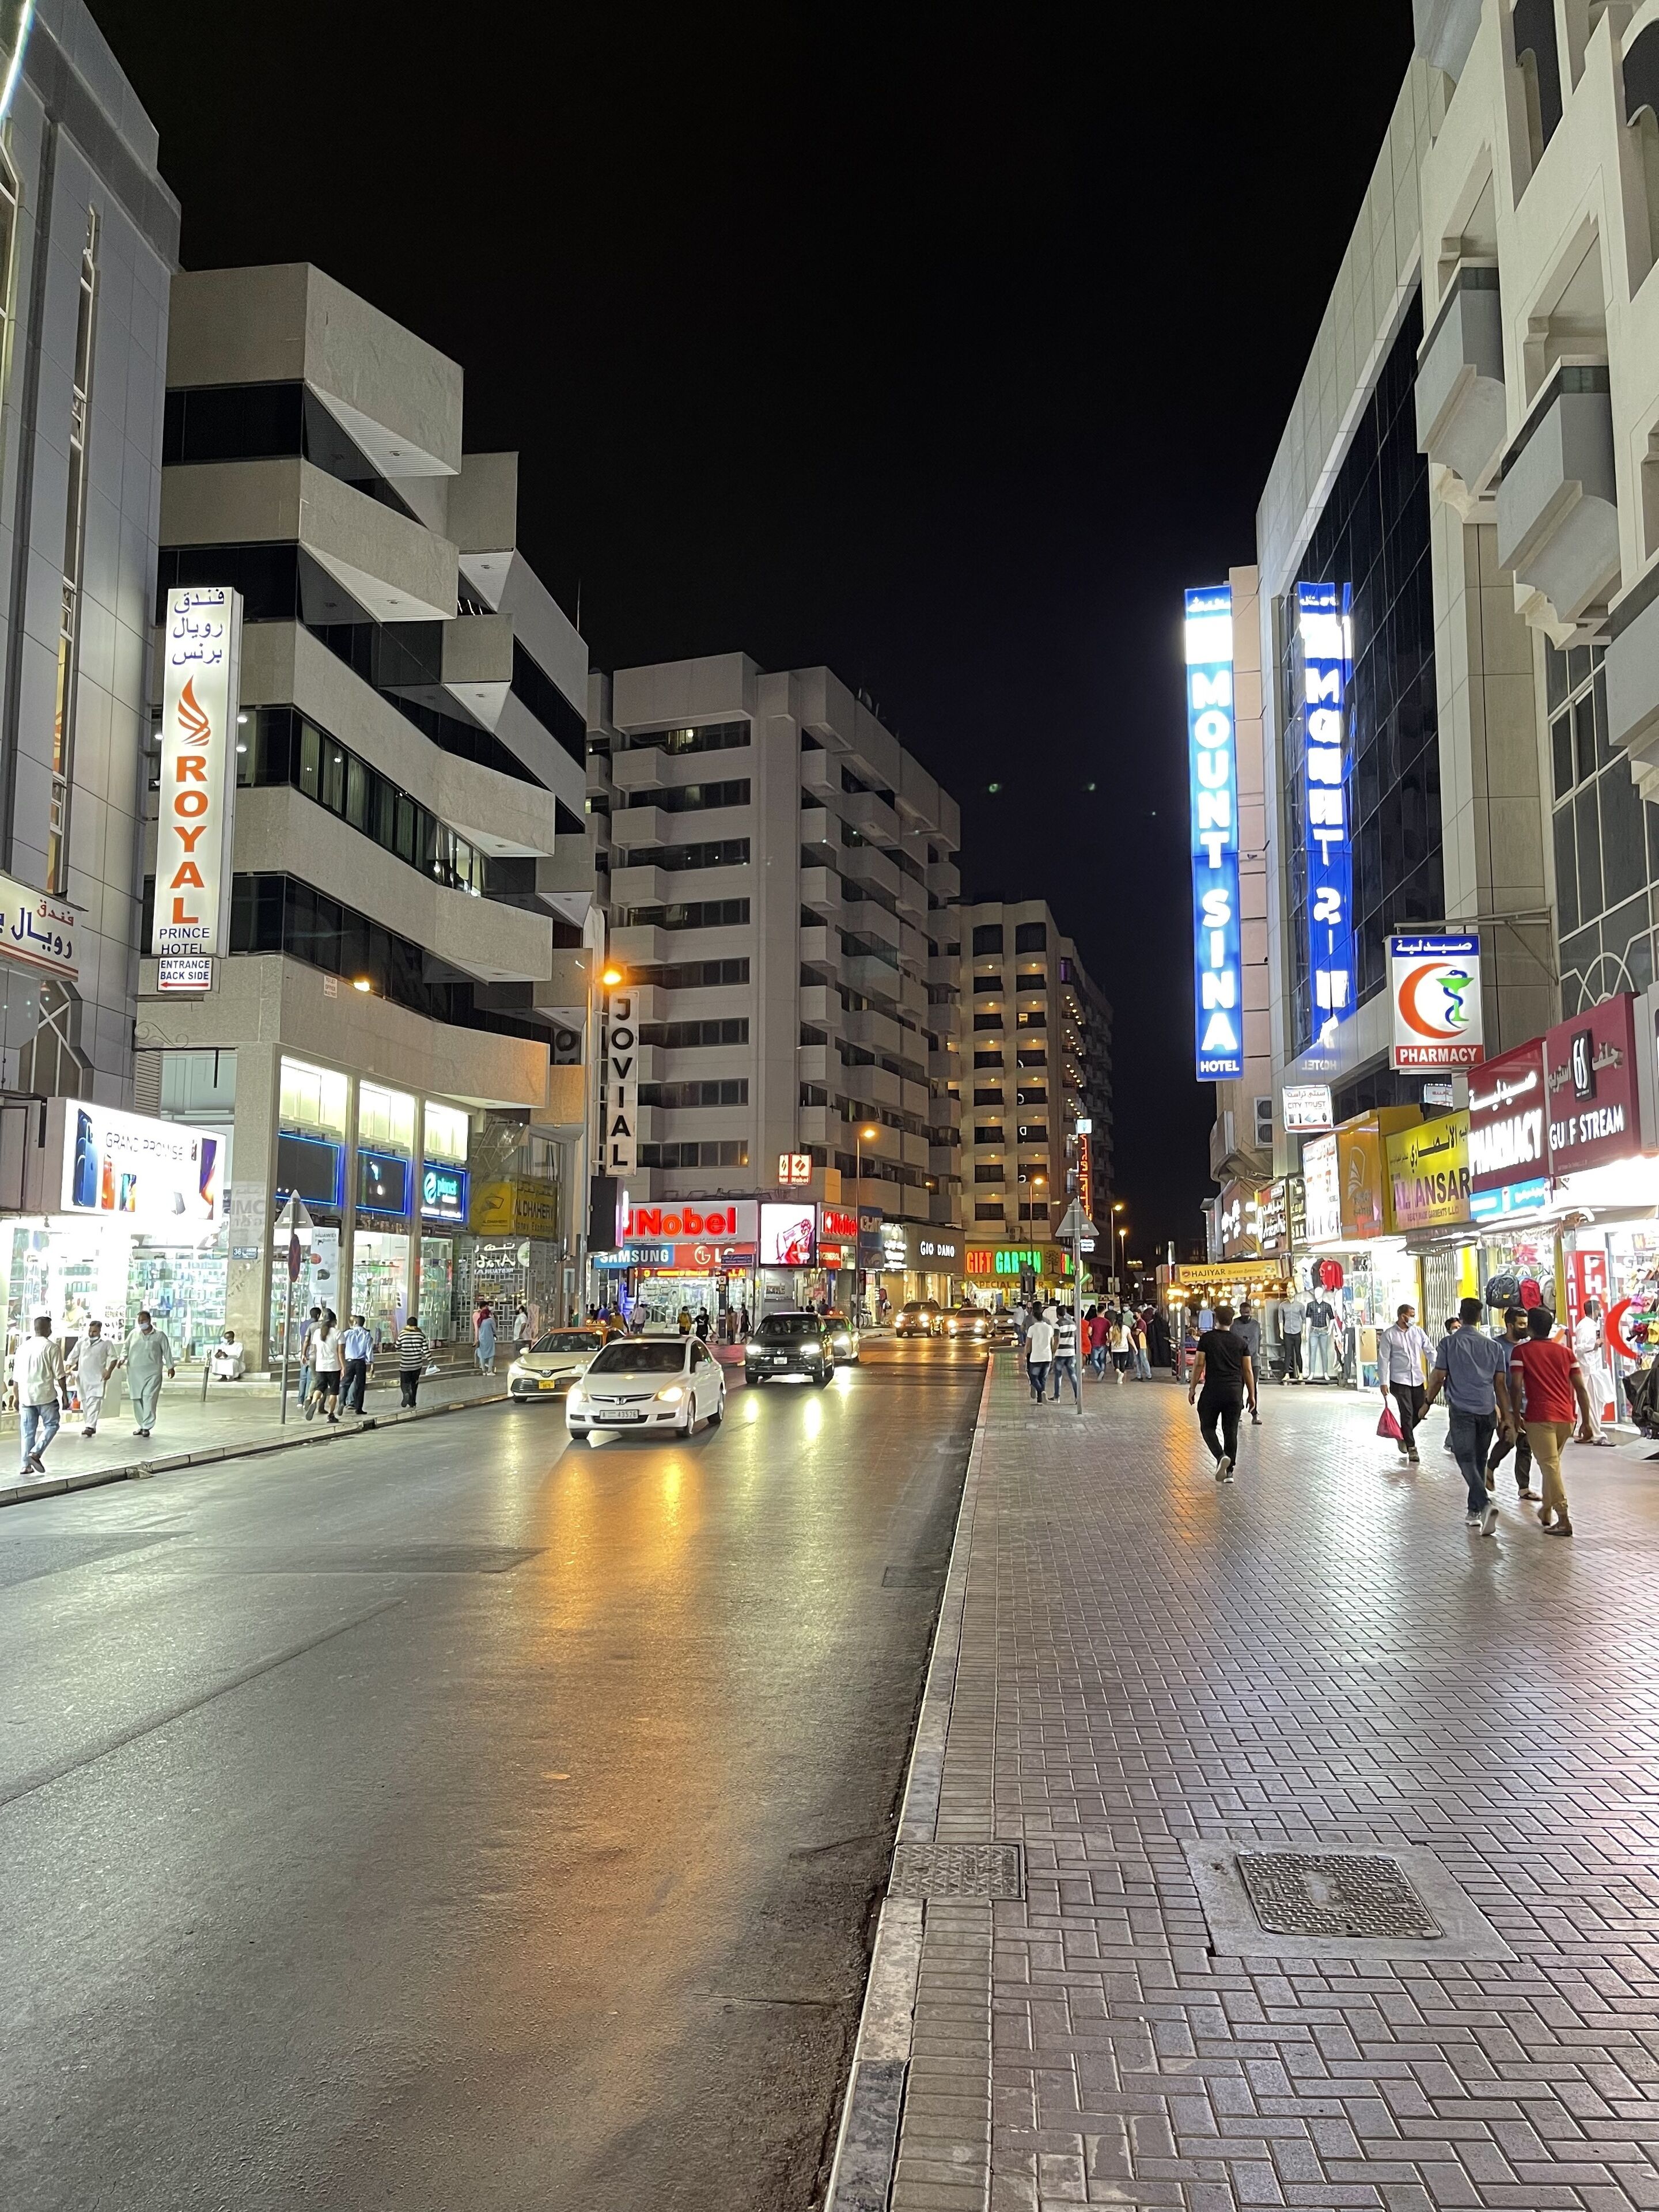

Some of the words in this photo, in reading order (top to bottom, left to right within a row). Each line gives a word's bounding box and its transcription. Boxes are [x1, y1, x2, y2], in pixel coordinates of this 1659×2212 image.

[174, 589, 225, 614] فندق
[173, 616, 224, 638] رويال
[172, 643, 222, 665] برنس
[1192, 669, 1230, 869] MOUNT
[170, 756, 208, 924] ROYAL
[37, 899, 74, 927] فندق
[10, 907, 73, 959] رويال
[160, 927, 210, 940] PRINCE
[162, 943, 207, 955] HOTEL
[1396, 940, 1473, 955] صيدلية
[160, 971, 185, 980] BACK
[188, 971, 209, 980] SIDE
[161, 960, 210, 969] ENTRANCE
[1201, 888, 1238, 1051] SINA
[1200, 1060, 1240, 1072] HOTEL
[1399, 1048, 1477, 1063] PHARMACY
[611, 998, 634, 1165] JOVIAL
[1580, 1103, 1624, 1143] STREAM
[637, 1207, 738, 1237] Nobel
[920, 1241, 934, 1256] GIO
[966, 1251, 993, 1274] GIFT
[1191, 1268, 1226, 1278] HAJIYAR
